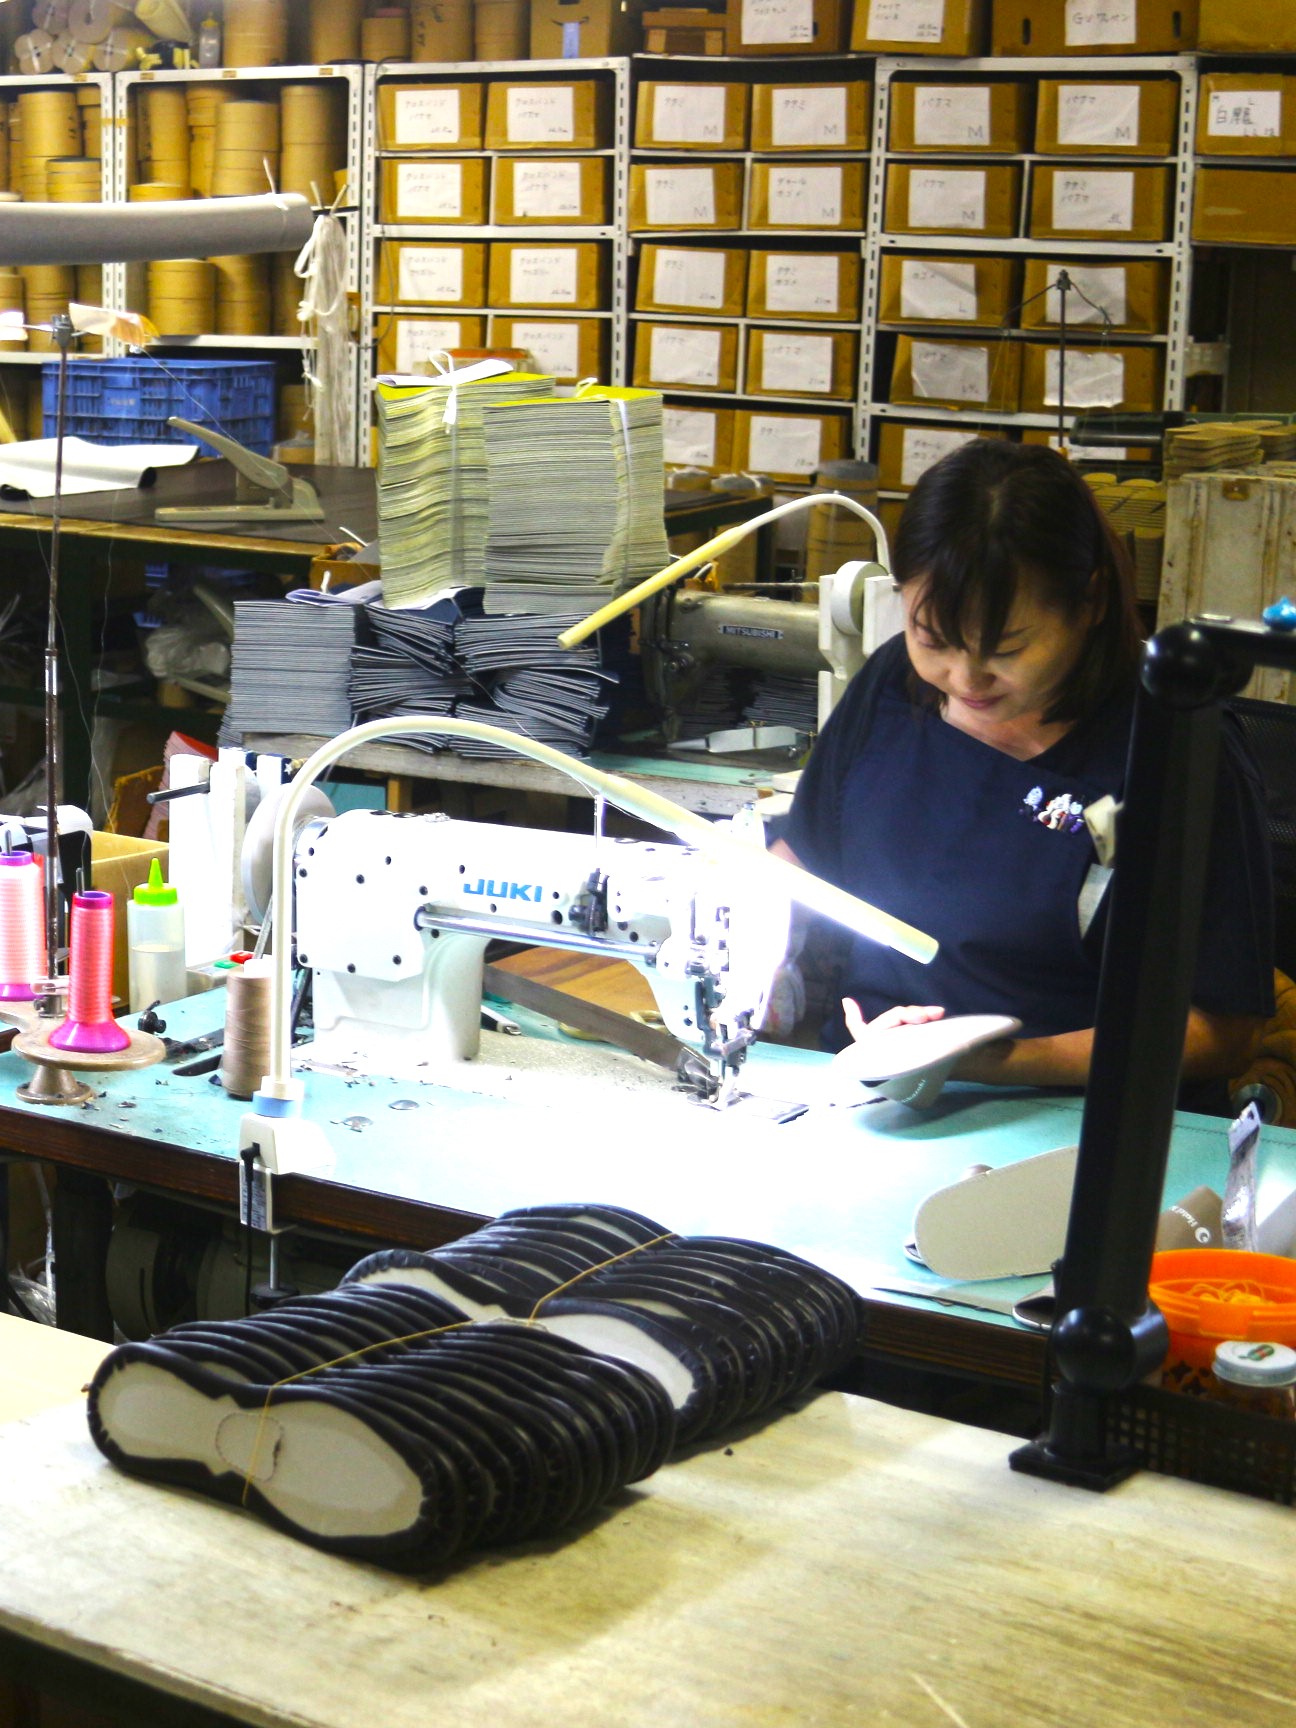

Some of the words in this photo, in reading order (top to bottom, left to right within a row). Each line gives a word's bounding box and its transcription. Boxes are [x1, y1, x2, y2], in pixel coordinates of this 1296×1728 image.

[703, 125, 718, 135] M
[824, 124, 837, 135] M
[968, 125, 983, 139] M
[1115, 126, 1130, 139] M
[694, 206, 707, 217] M
[822, 207, 834, 218] M
[962, 210, 975, 221] M
[463, 879, 543, 903] JUKI
